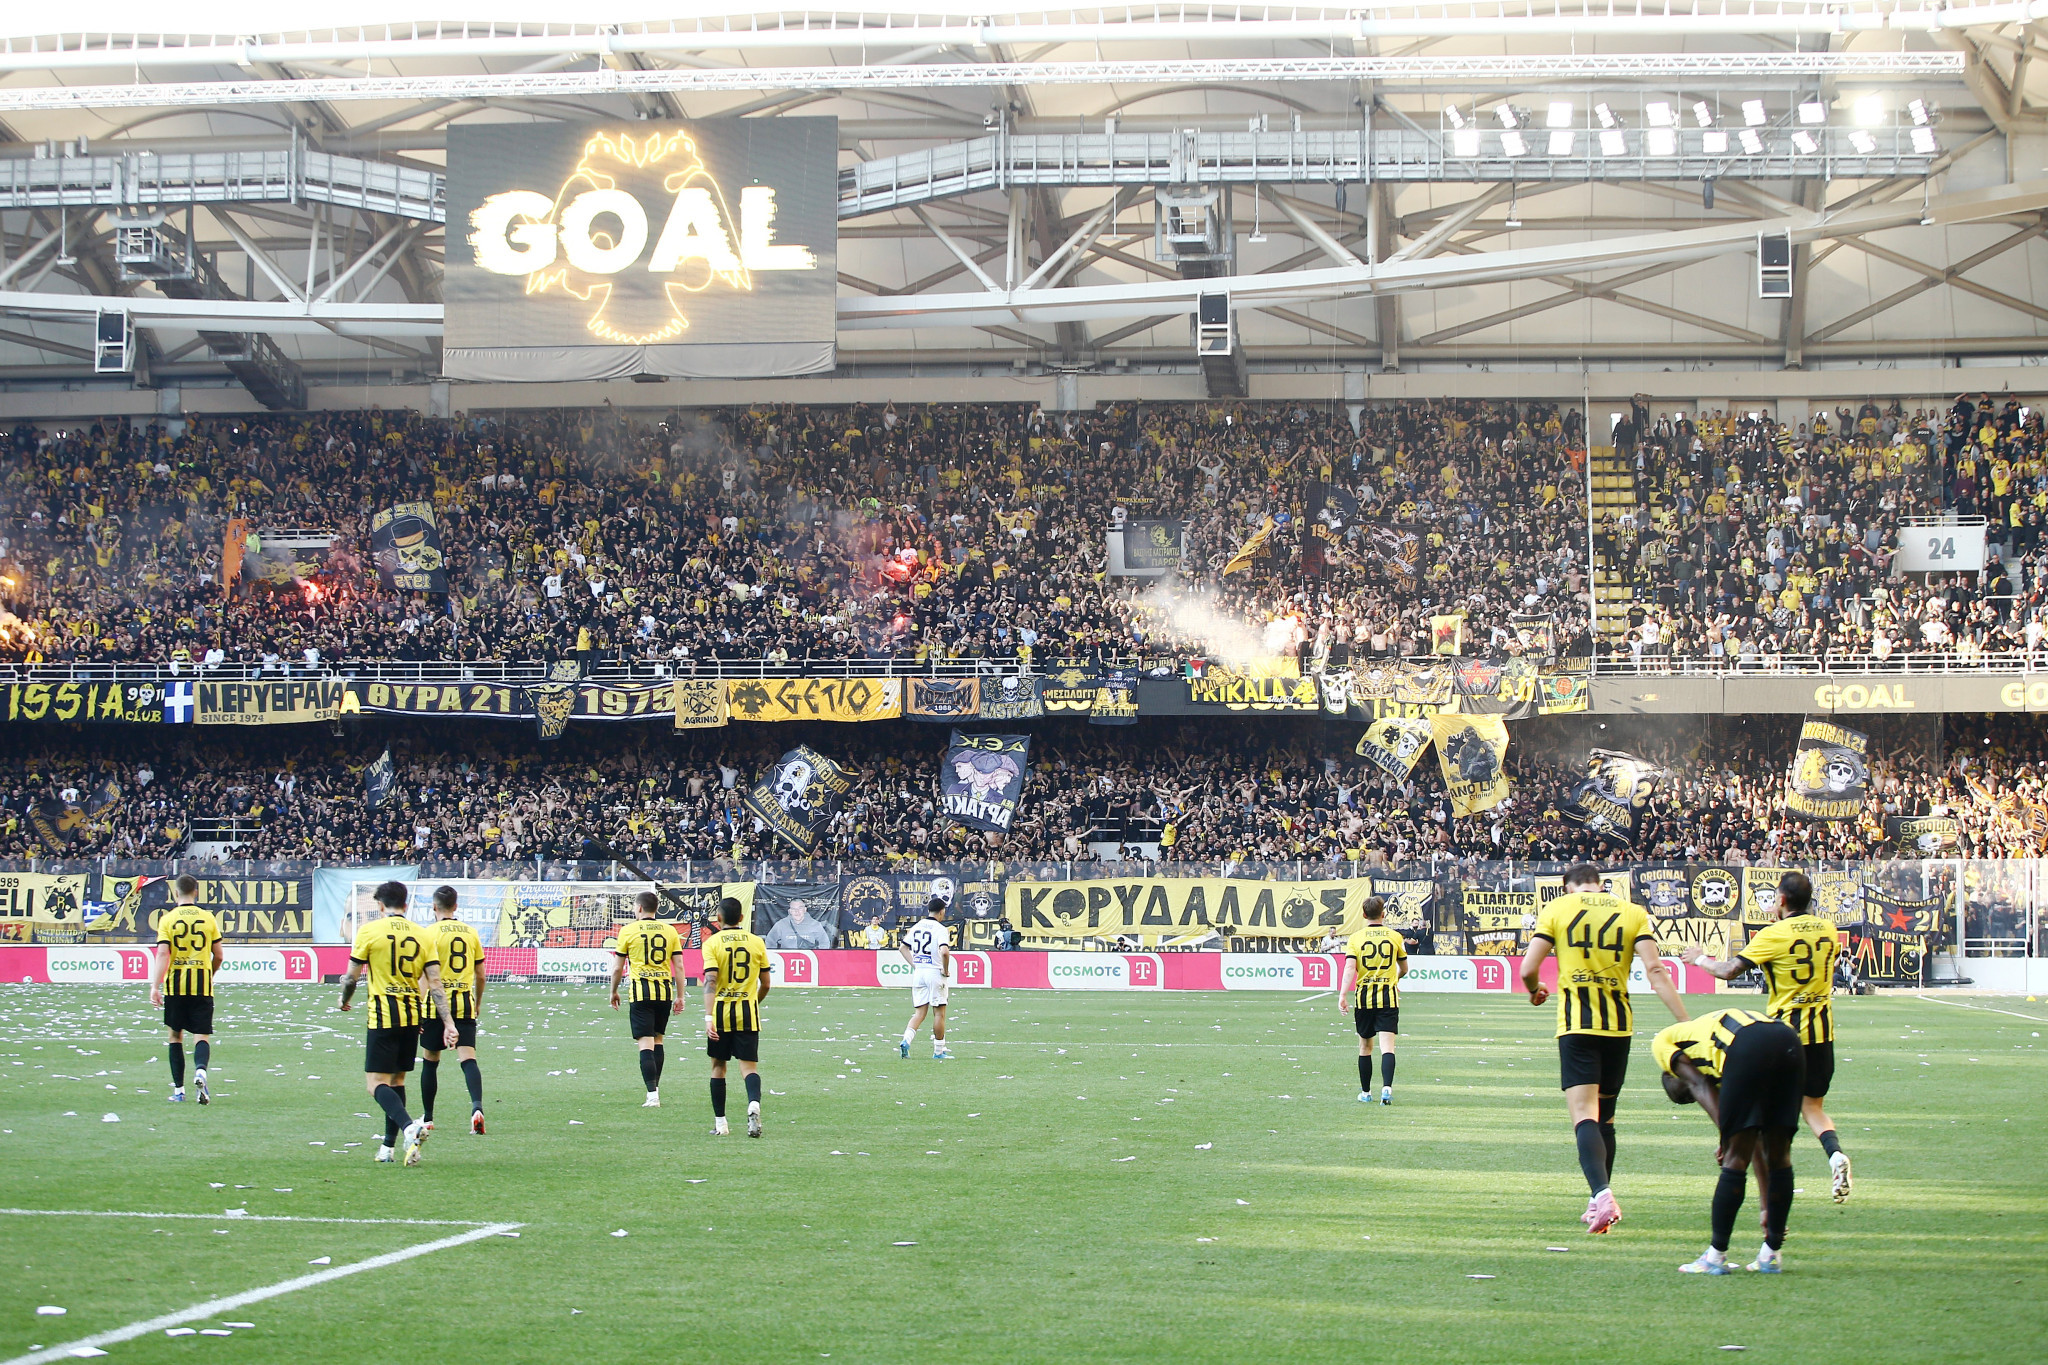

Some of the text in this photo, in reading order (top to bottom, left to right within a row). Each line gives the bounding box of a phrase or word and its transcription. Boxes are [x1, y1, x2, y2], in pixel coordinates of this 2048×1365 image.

[466, 187, 818, 275] GOAL
[1928, 537, 1956, 560] 24
[0, 683, 124, 722] ISSIA
[471, 685, 511, 713] 21
[580, 687, 675, 716] 1975
[913, 682, 974, 710] KOZANI
[1814, 683, 1915, 709] GOAL
[125, 710, 161, 723] CLUB
[201, 714, 264, 723] SINCE 1974
[683, 715, 719, 724] AGRINIO
[1640, 869, 1687, 884] ORIGINAL
[1703, 869, 1726, 878] LIOSIA
[1750, 870, 1782, 881] ΠΟΝΤ
[899, 880, 932, 893] KAMA
[1374, 880, 1433, 894] KIATO 21
[1466, 892, 1535, 906] ALIARTOS
[1867, 888, 1940, 907] MARKOPOULO
[413, 907, 501, 923] MASEILL
[1478, 906, 1524, 916] ORIGINAL
[1651, 902, 1689, 917] RDITSA
[1866, 901, 1940, 931] R 21
[149, 908, 312, 933] OGINA
[1491, 917, 1509, 927] 21
[172, 919, 207, 952] 25
[913, 930, 932, 955] 52
[1566, 909, 1624, 962] 44
[1878, 930, 1919, 944] LOUTSA
[386, 934, 421, 977] 12
[450, 936, 467, 974] 8
[640, 933, 667, 965] 18
[1361, 940, 1394, 971] 29
[51, 960, 115, 972] COSMOTE
[218, 960, 277, 972] OSMOTE
[542, 961, 608, 973] COSMOTE
[725, 946, 751, 984] 13
[1789, 936, 1834, 985] 37
[1053, 965, 1121, 977] COSMOTE
[1226, 966, 1294, 978] COSMOTE
